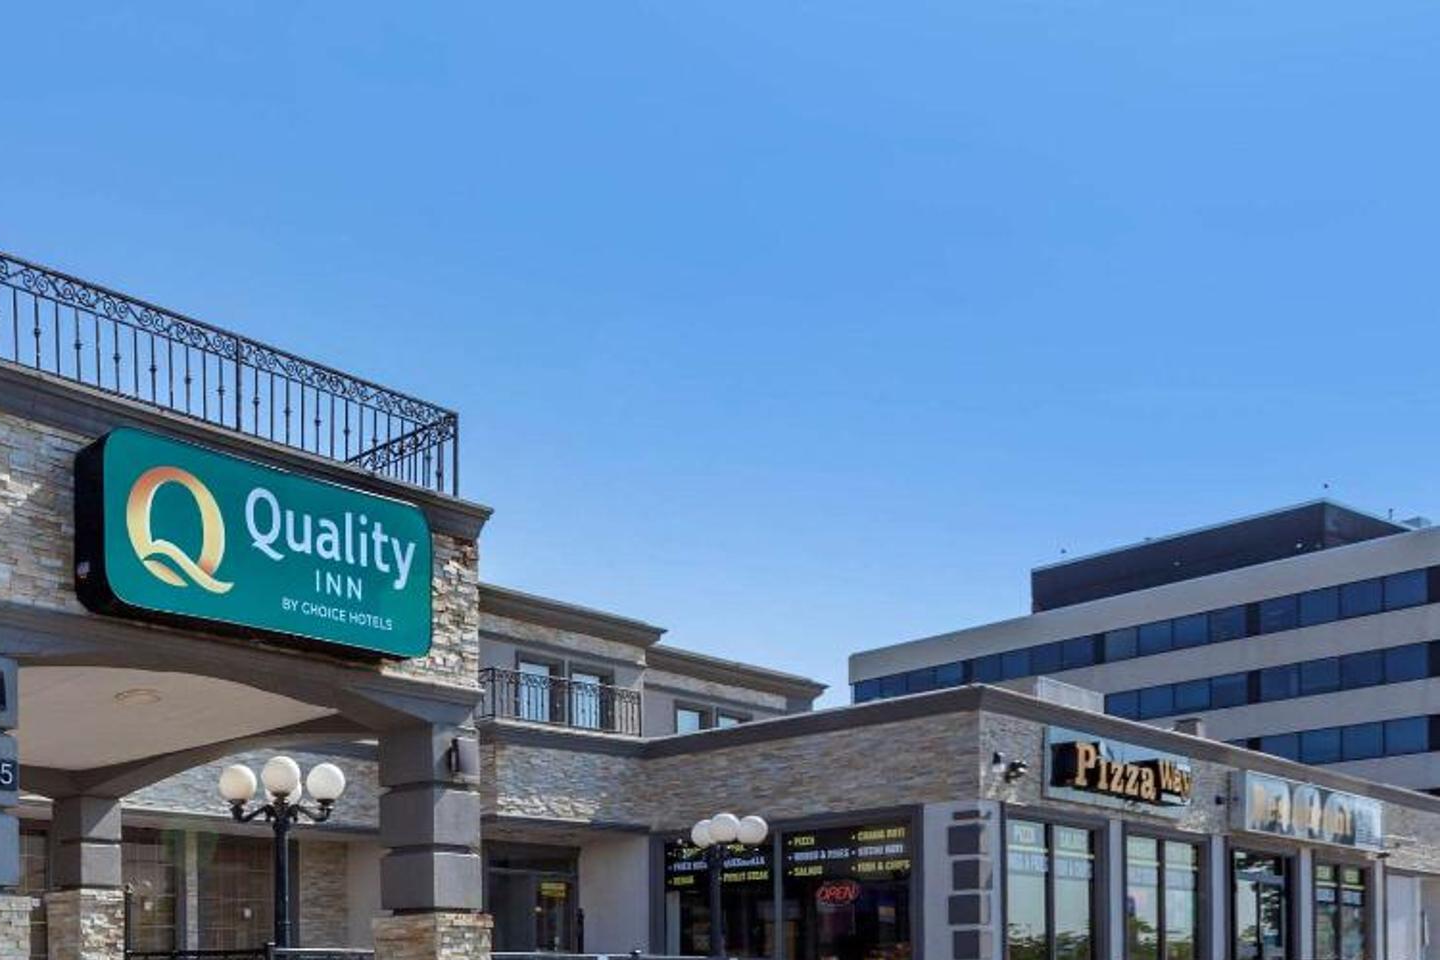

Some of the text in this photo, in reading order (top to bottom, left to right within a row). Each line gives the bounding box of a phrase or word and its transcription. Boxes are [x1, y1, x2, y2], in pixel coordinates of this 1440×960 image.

[244, 487, 416, 590] Quality
[315, 569, 363, 601] INN
[281, 597, 393, 631] BY CHOICE HOTELS
[1074, 742, 1157, 801] Pizza
[816, 885, 858, 902] OPEN
